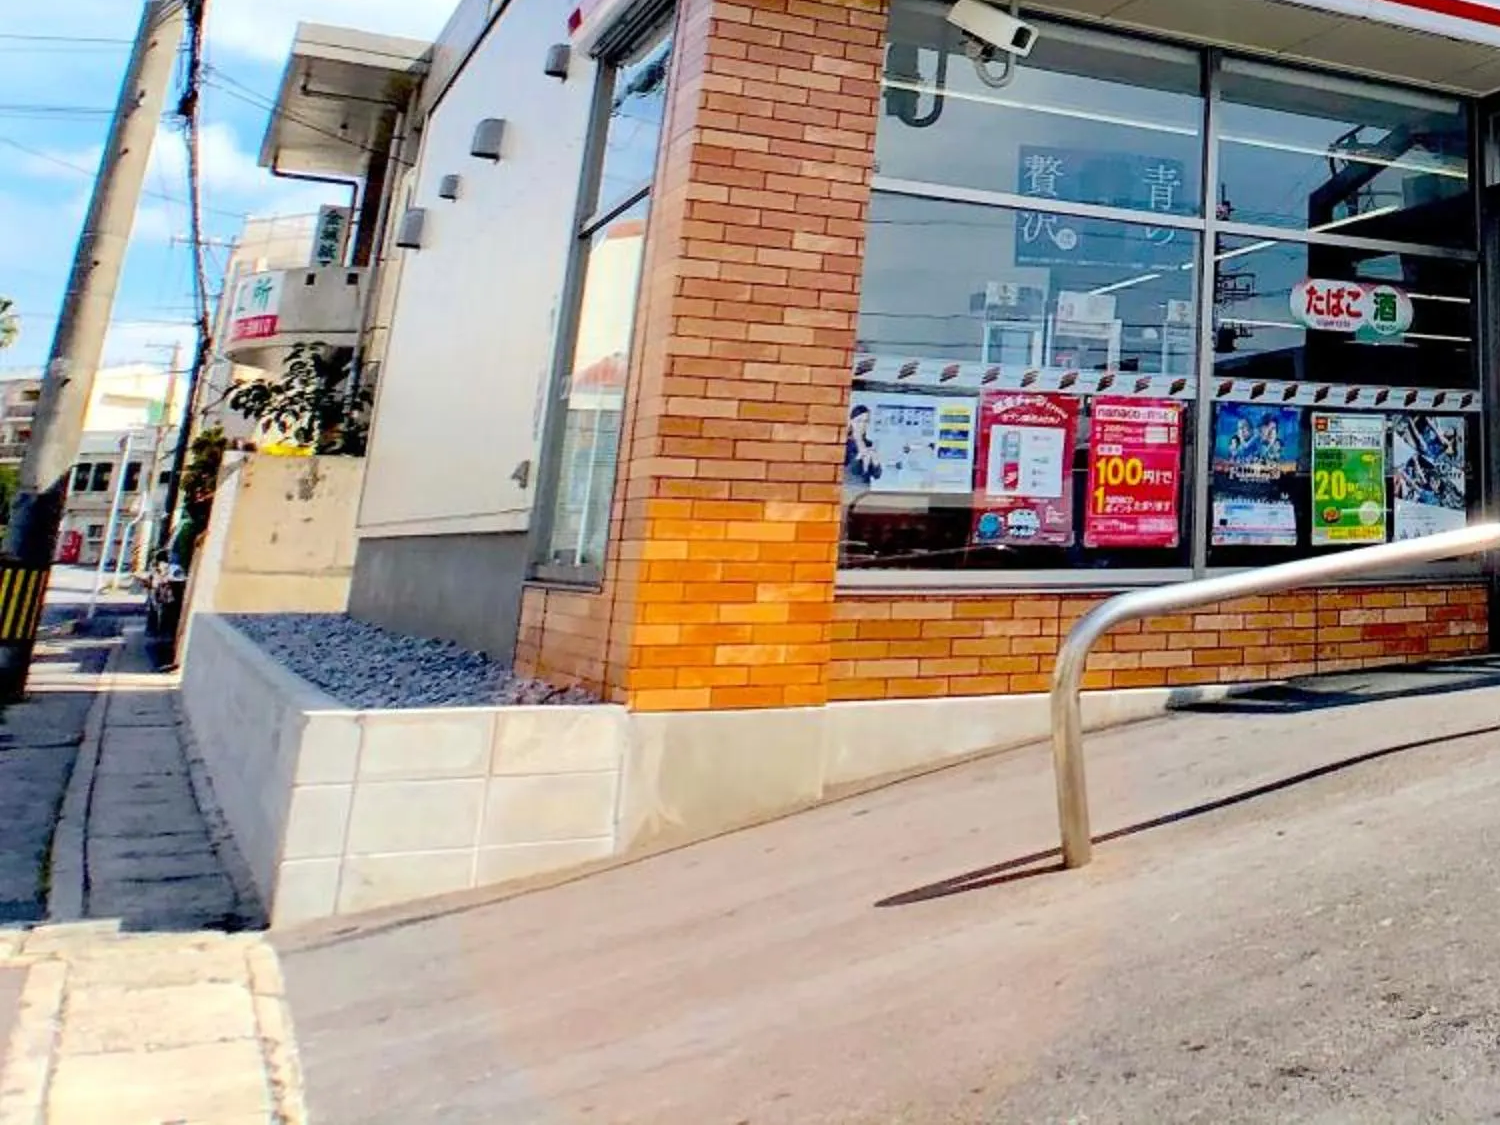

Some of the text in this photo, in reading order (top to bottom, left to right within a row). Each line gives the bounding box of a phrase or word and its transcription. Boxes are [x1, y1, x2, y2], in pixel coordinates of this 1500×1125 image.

[1306, 285, 1397, 322] たばこ 酒
